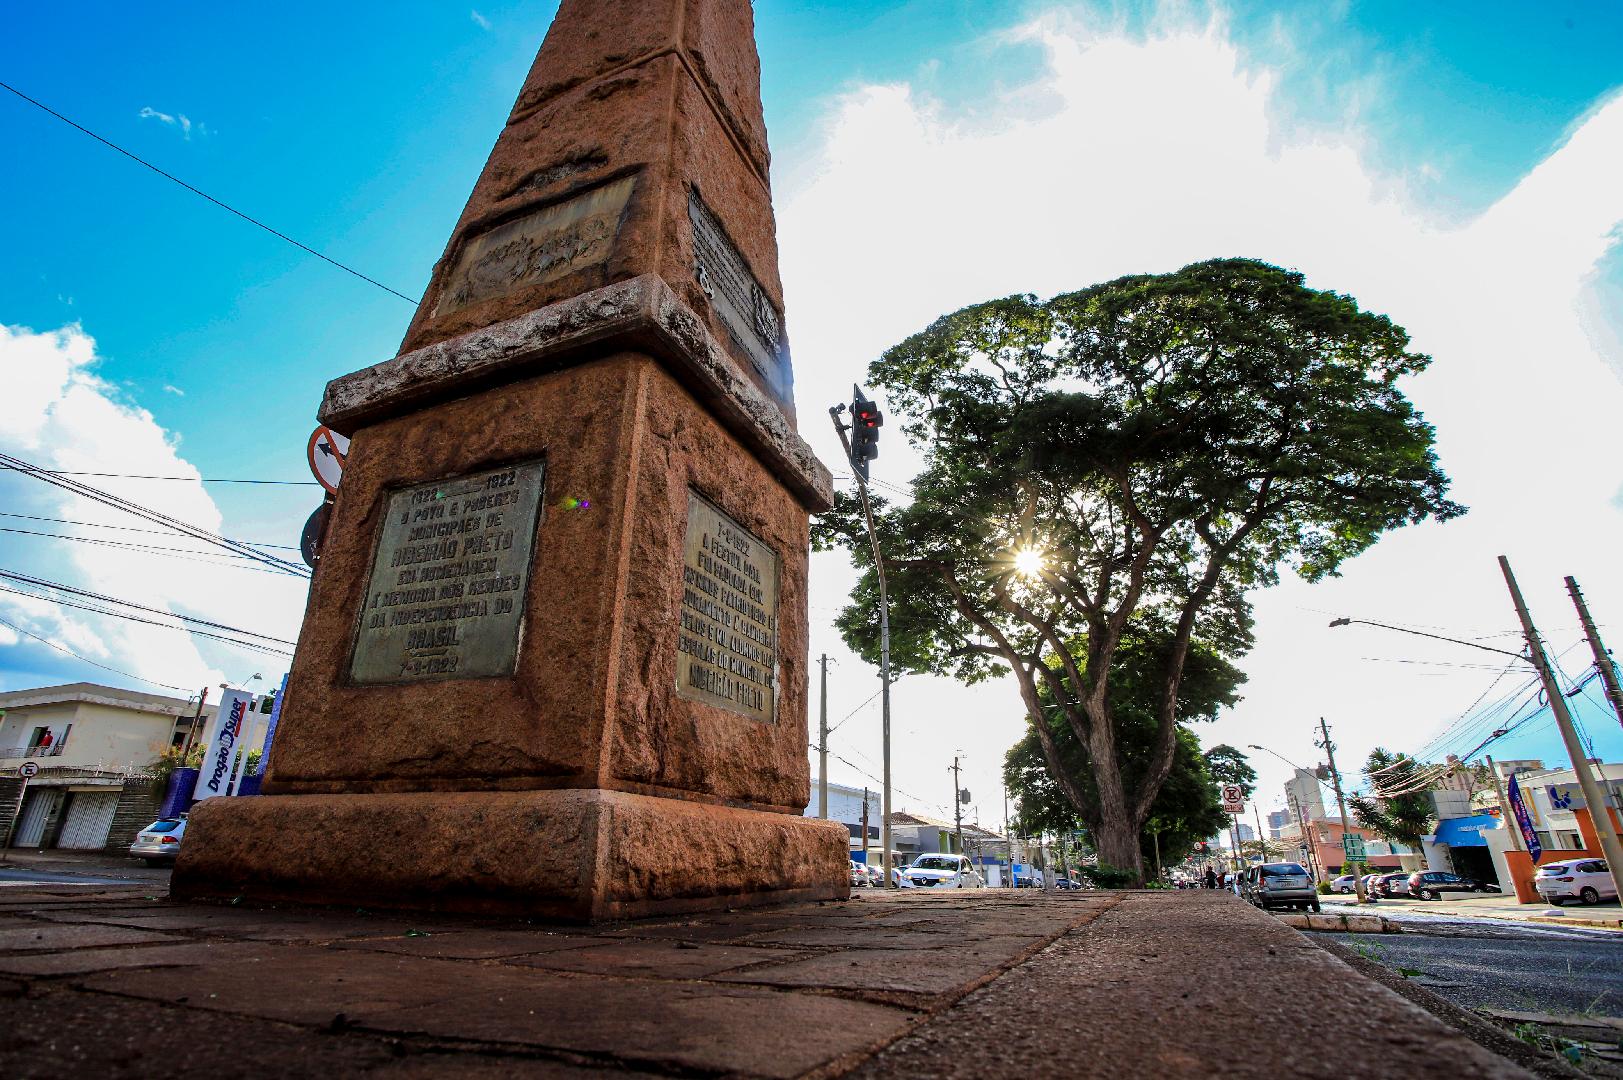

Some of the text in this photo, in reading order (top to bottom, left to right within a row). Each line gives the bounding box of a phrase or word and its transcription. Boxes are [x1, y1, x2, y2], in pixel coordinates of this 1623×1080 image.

[487, 471, 516, 490] 1922
[413, 503, 444, 523] POVO
[449, 501, 458, 516] E
[463, 489, 520, 514] PODERES
[485, 512, 504, 528] DE
[463, 530, 514, 556] PRETO
[494, 598, 513, 615] DO
[404, 626, 459, 650] BRASIL
[709, 625, 714, 641] 5
[718, 651, 729, 670] DO
[736, 681, 764, 712] PRETO
[207, 697, 242, 792] Drogão Super
